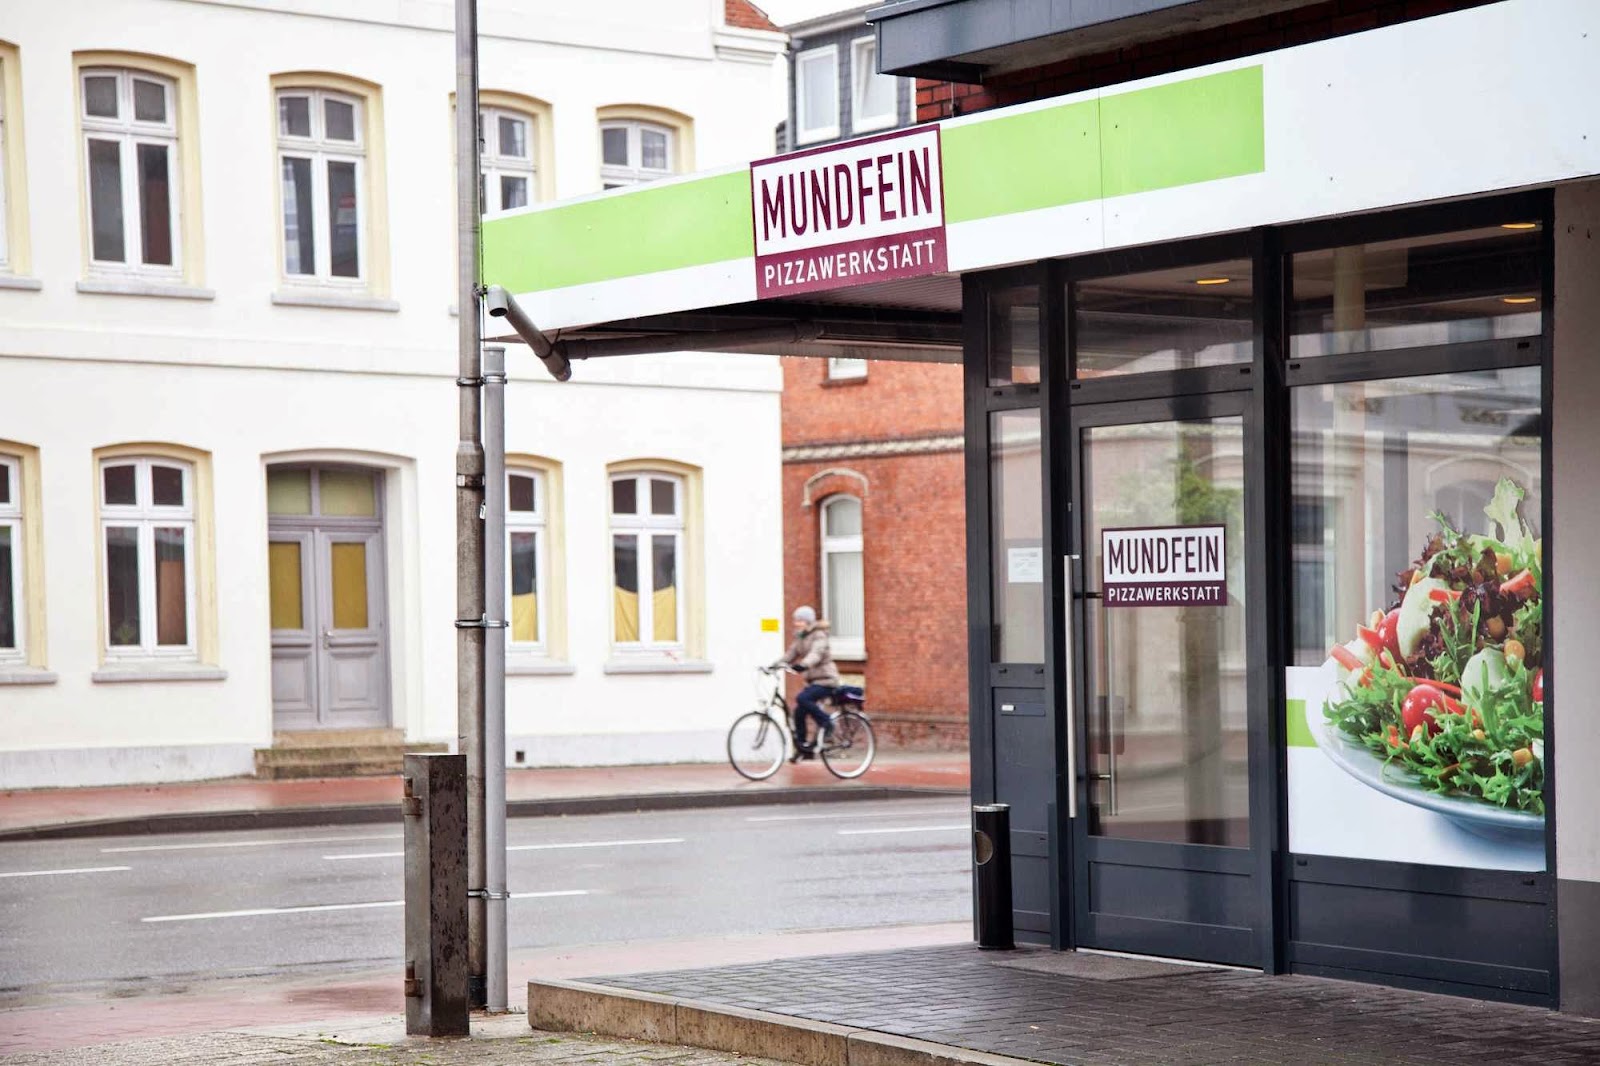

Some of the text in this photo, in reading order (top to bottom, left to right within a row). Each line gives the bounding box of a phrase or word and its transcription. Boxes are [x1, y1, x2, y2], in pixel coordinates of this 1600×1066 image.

[761, 146, 933, 241] MUNDFEIN
[764, 239, 936, 289] PIZZAWERKSTATT
[1108, 535, 1220, 575] MUNDFEIN
[1108, 586, 1221, 602] PIZZAWERKSTATT
